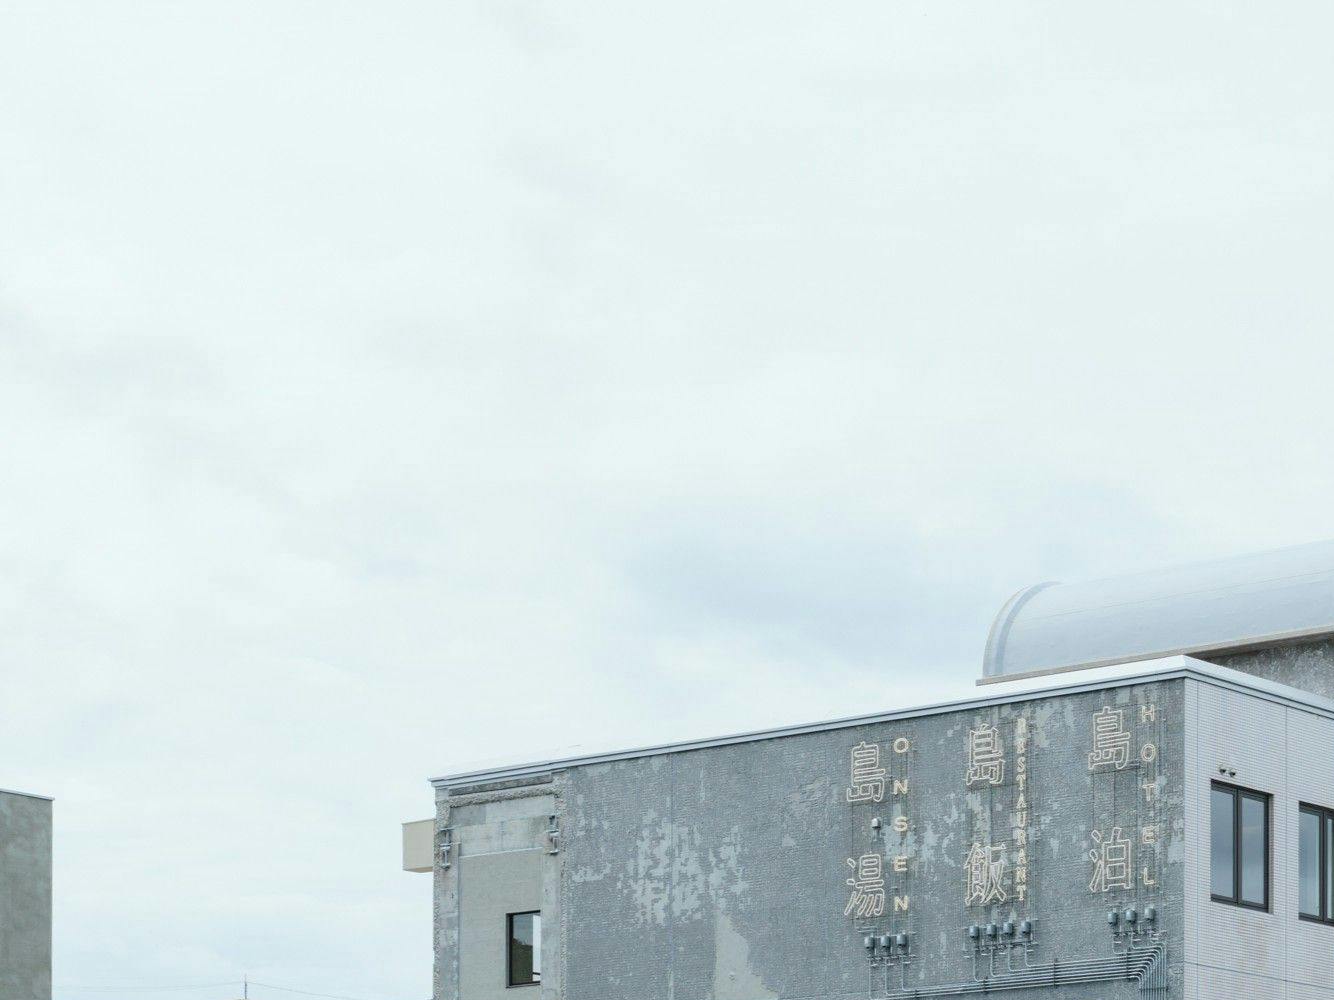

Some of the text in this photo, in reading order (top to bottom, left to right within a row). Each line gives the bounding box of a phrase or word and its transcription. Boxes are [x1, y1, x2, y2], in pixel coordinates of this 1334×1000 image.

[844, 741, 886, 917] 島湯
[893, 737, 909, 911] ONSEN
[964, 723, 1007, 906] 島飯
[1016, 718, 1028, 901] RESTAURANT
[1088, 706, 1132, 892] 島泊
[1140, 705, 1156, 885] HOTEL
